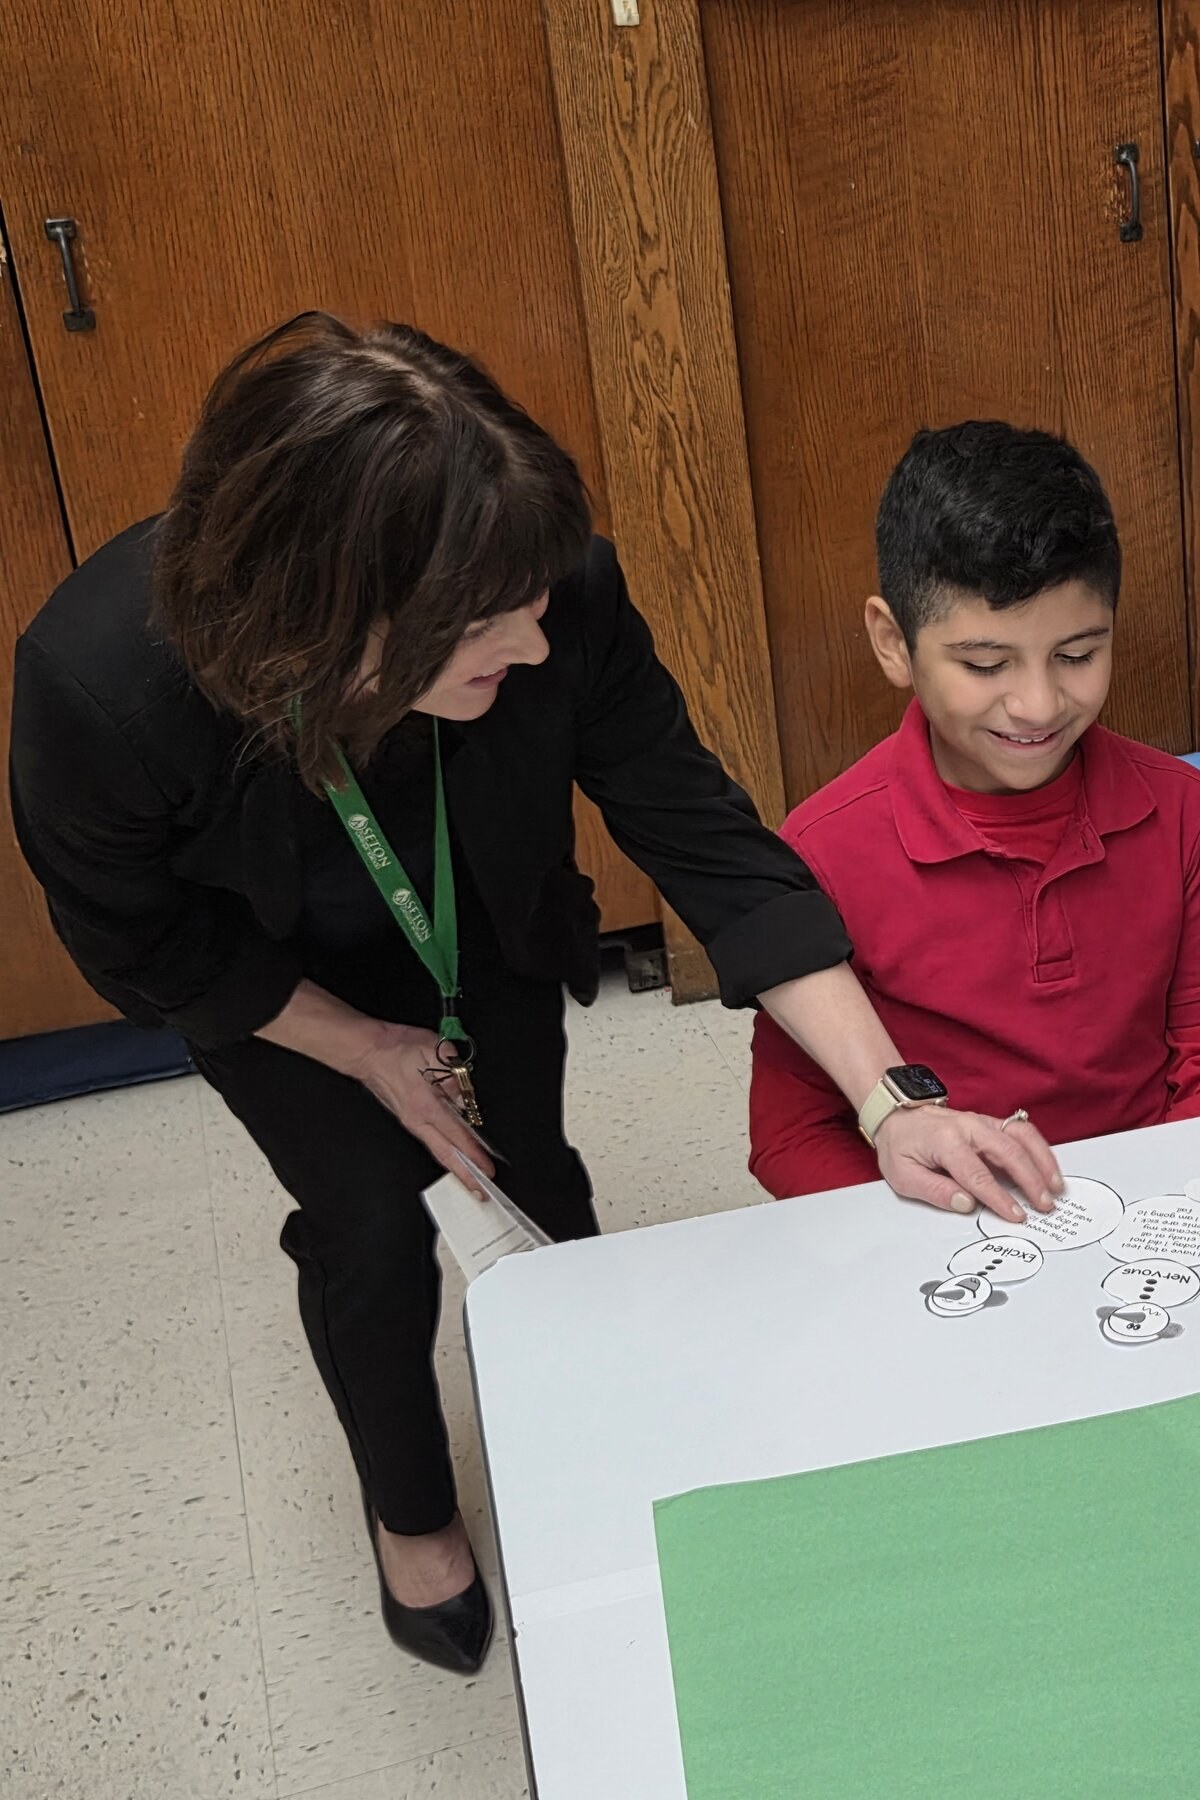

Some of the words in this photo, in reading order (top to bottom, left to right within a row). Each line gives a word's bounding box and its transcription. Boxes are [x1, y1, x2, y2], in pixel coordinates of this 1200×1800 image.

[363, 827, 391, 868] SETON
[406, 900, 432, 941] SETON
[1069, 1202, 1087, 1211] new
[1073, 1213, 1093, 1223] wait
[1150, 1210, 1176, 1219] going
[1040, 1218, 1061, 1231] going
[1056, 1215, 1072, 1226] dog
[1049, 1232, 1066, 1242] This
[1062, 1228, 1077, 1236] are
[1168, 1233, 1196, 1241] study
[1121, 1242, 1141, 1250] test
[1144, 1244, 1159, 1253] big
[981, 1243, 1037, 1263] Excited
[1171, 1248, 1196, 1257] have
[1122, 1268, 1191, 1283] Nervous
